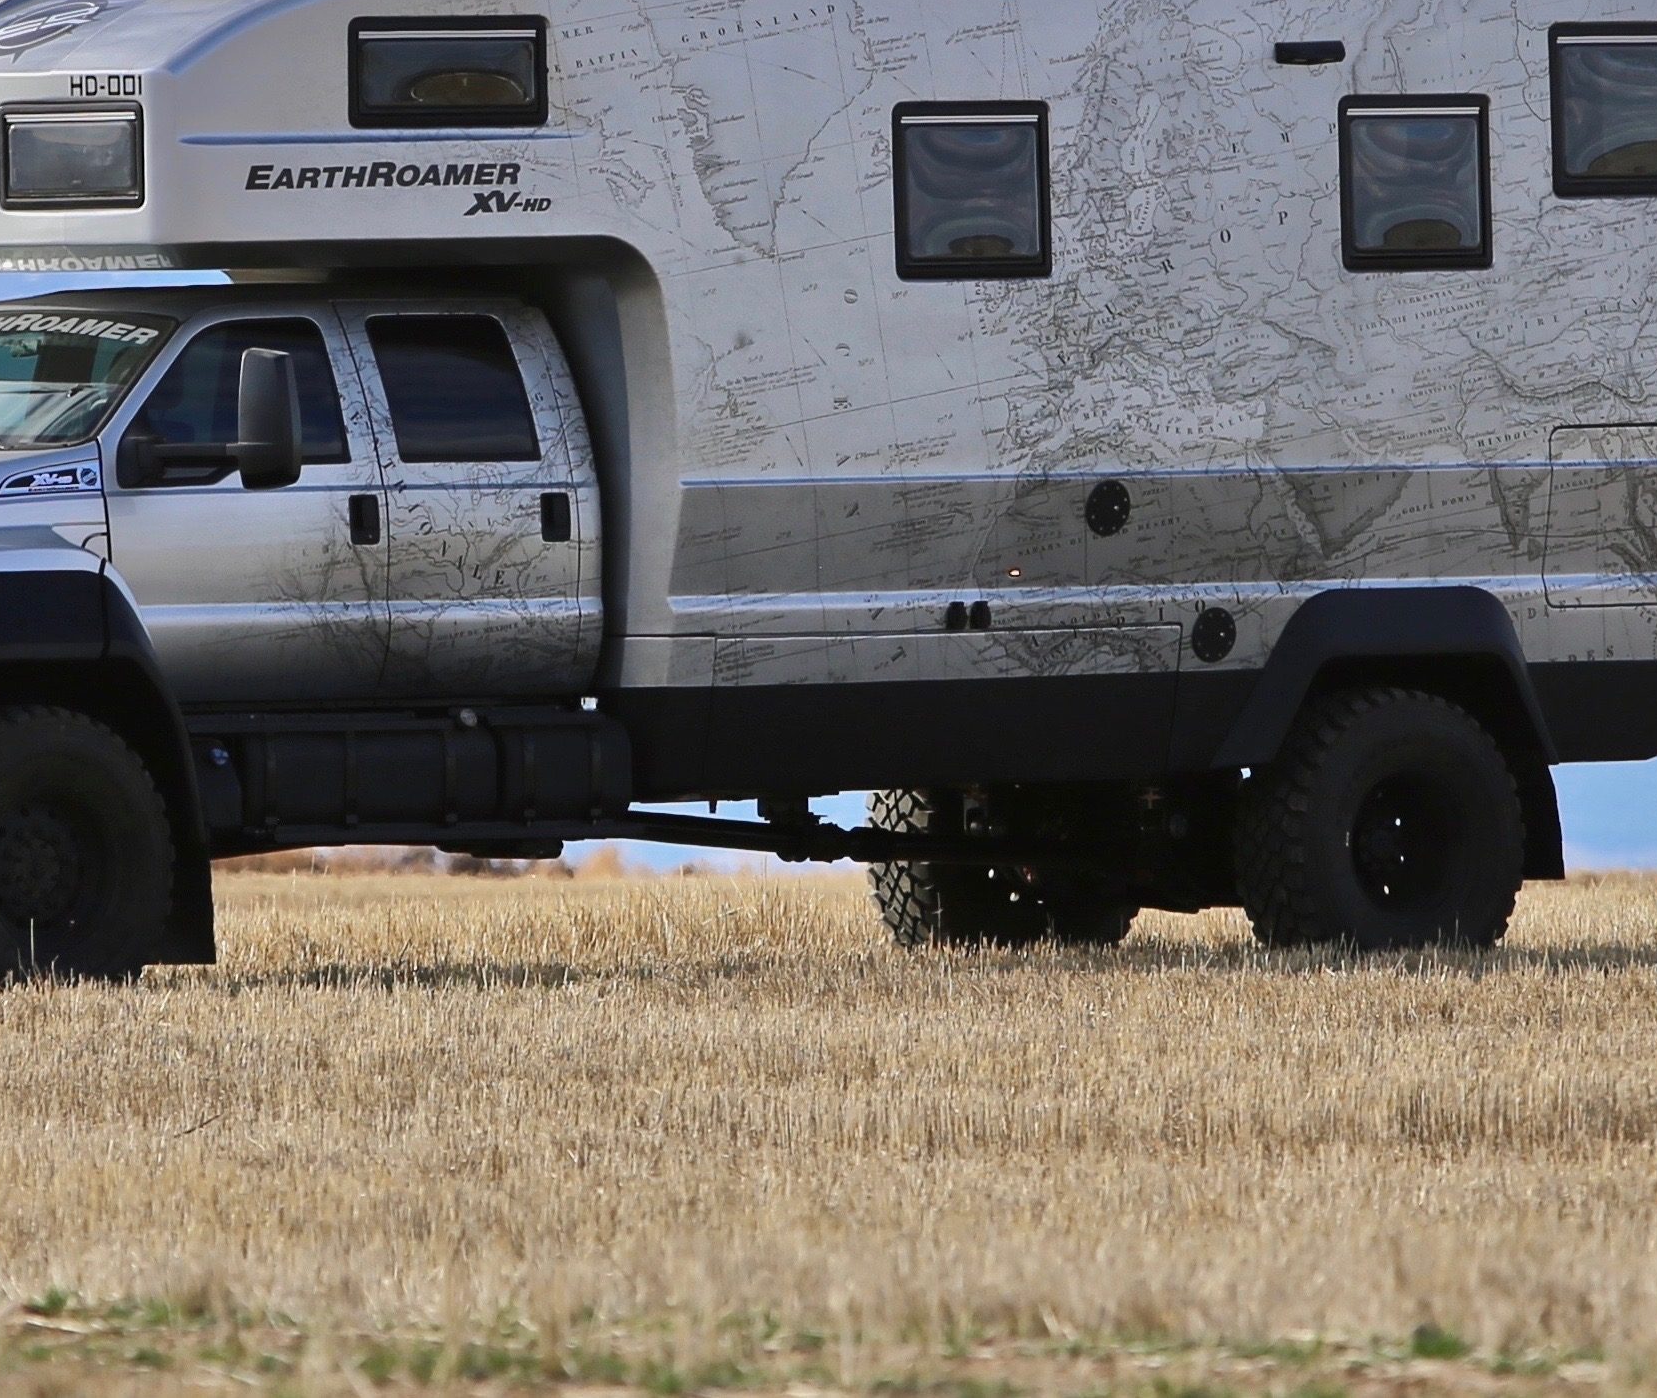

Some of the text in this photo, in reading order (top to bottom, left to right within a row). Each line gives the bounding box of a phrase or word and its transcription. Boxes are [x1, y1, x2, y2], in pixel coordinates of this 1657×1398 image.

[70, 75, 142, 96] HD-001
[245, 162, 521, 190] EARTHROAMER
[463, 190, 551, 216] XV-HD
